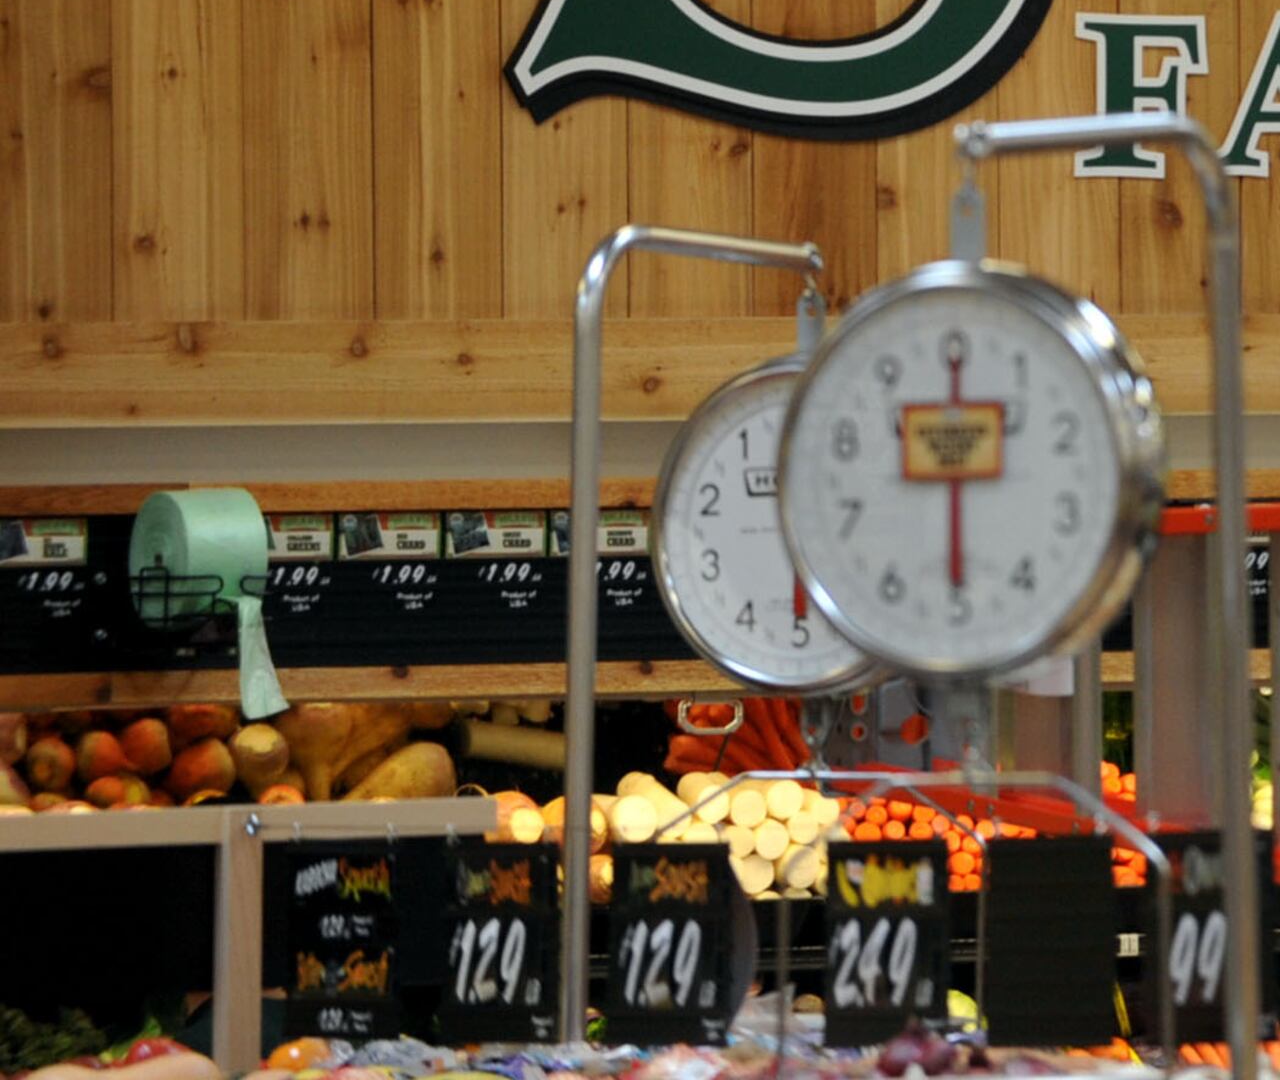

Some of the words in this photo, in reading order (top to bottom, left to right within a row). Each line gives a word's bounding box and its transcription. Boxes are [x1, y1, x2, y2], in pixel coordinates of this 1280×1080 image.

[700, 484, 720, 516] 2
[702, 549, 719, 581] 3
[736, 600, 755, 632] 4
[792, 617, 810, 648] 5
